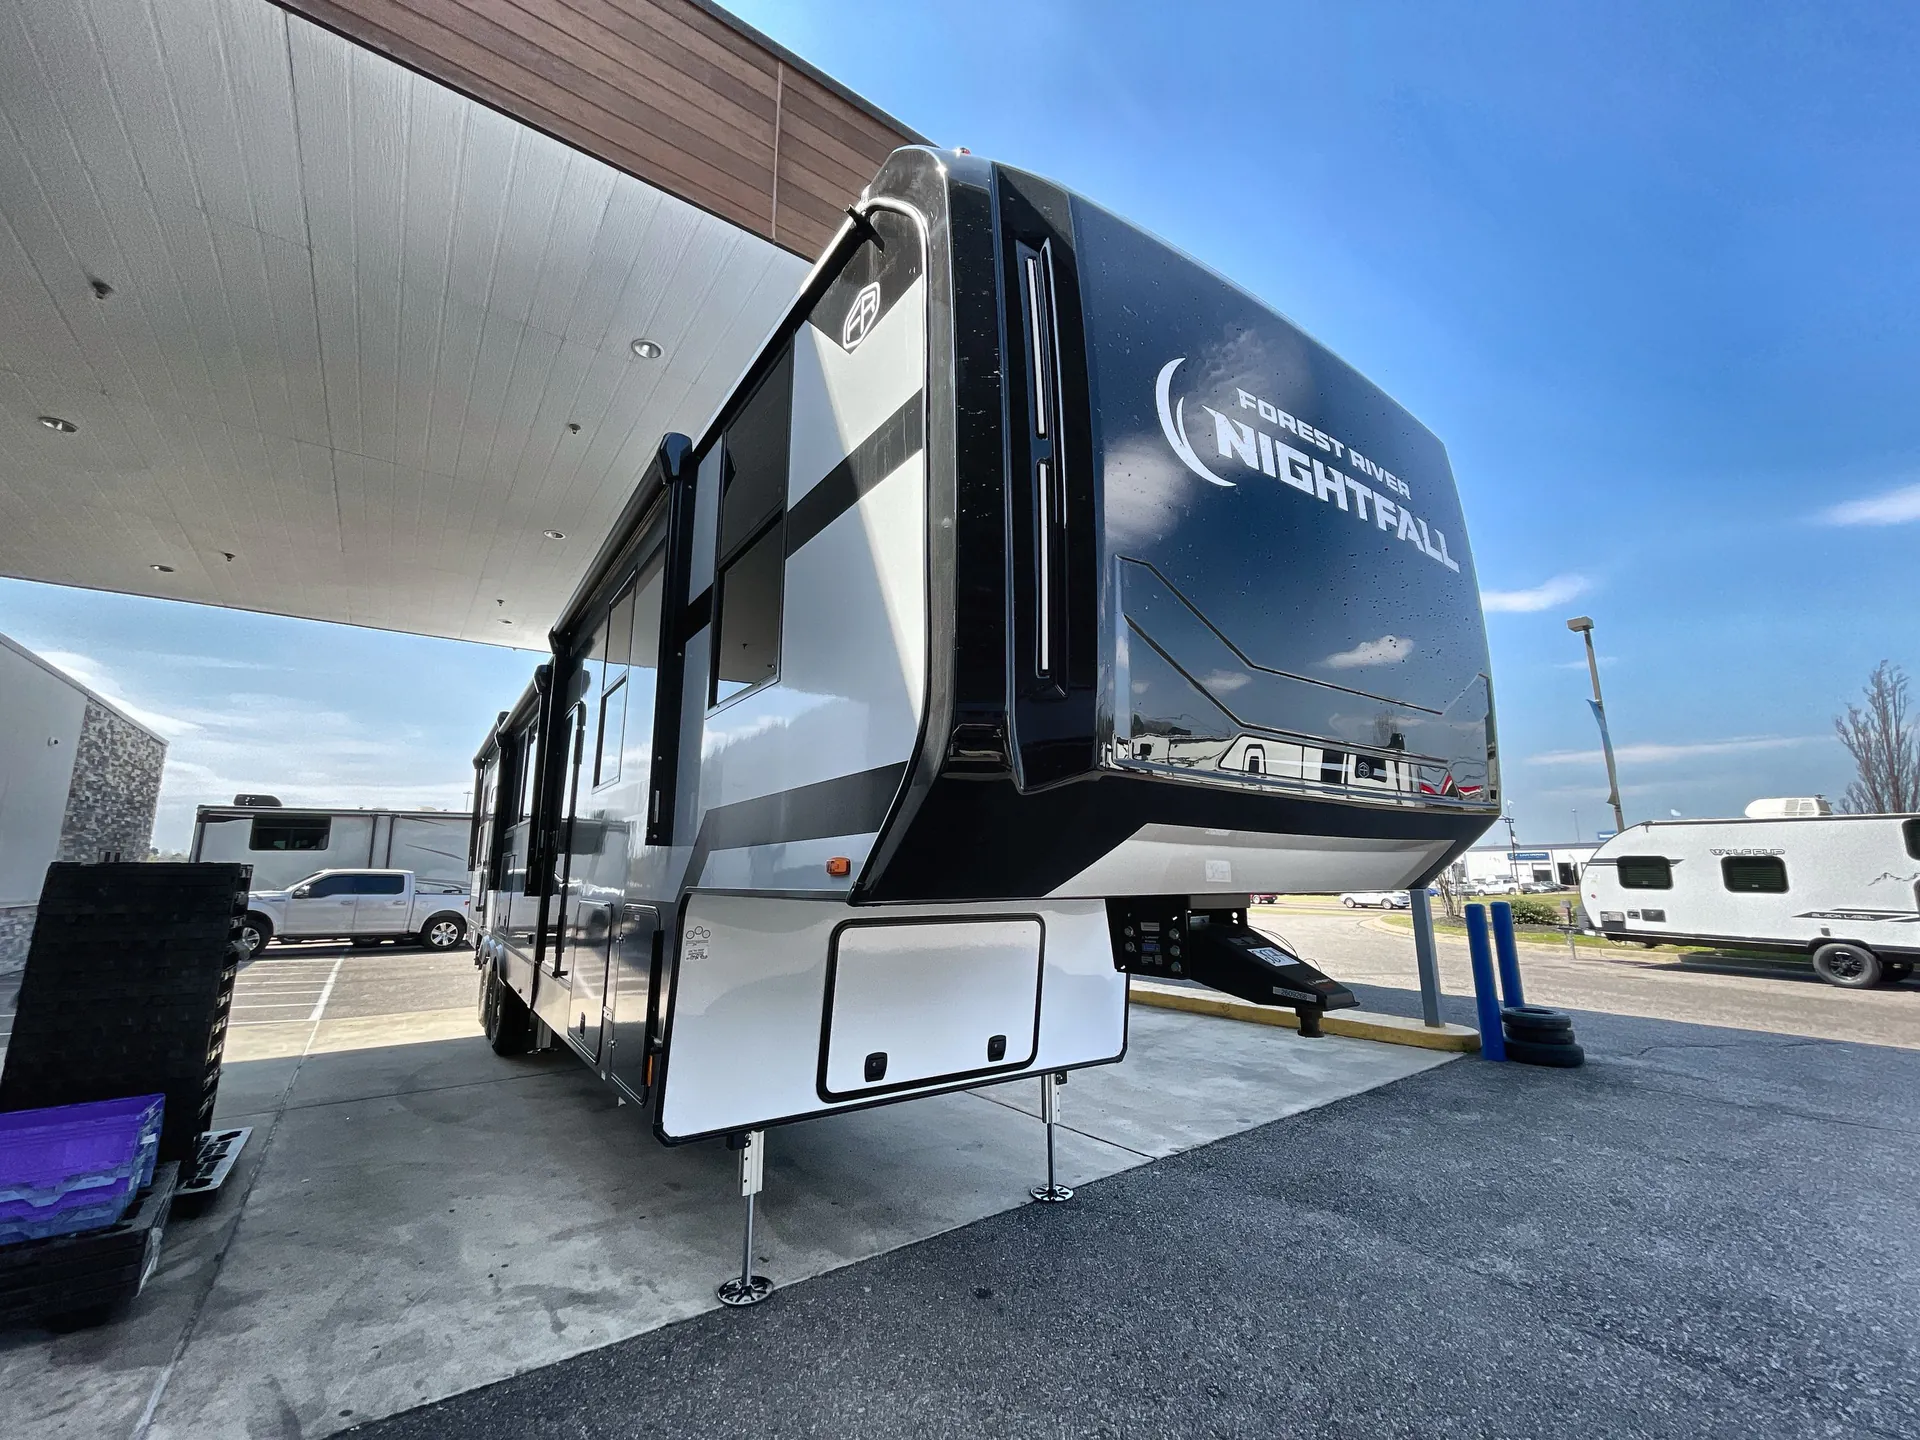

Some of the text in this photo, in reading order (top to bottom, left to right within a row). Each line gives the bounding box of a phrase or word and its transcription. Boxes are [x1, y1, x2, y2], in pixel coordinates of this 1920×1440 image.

[1202, 404, 1460, 573] NIGHTFALL
[1236, 387, 1412, 500] FOREST RIVER
[1753, 848, 1786, 856] PUP
